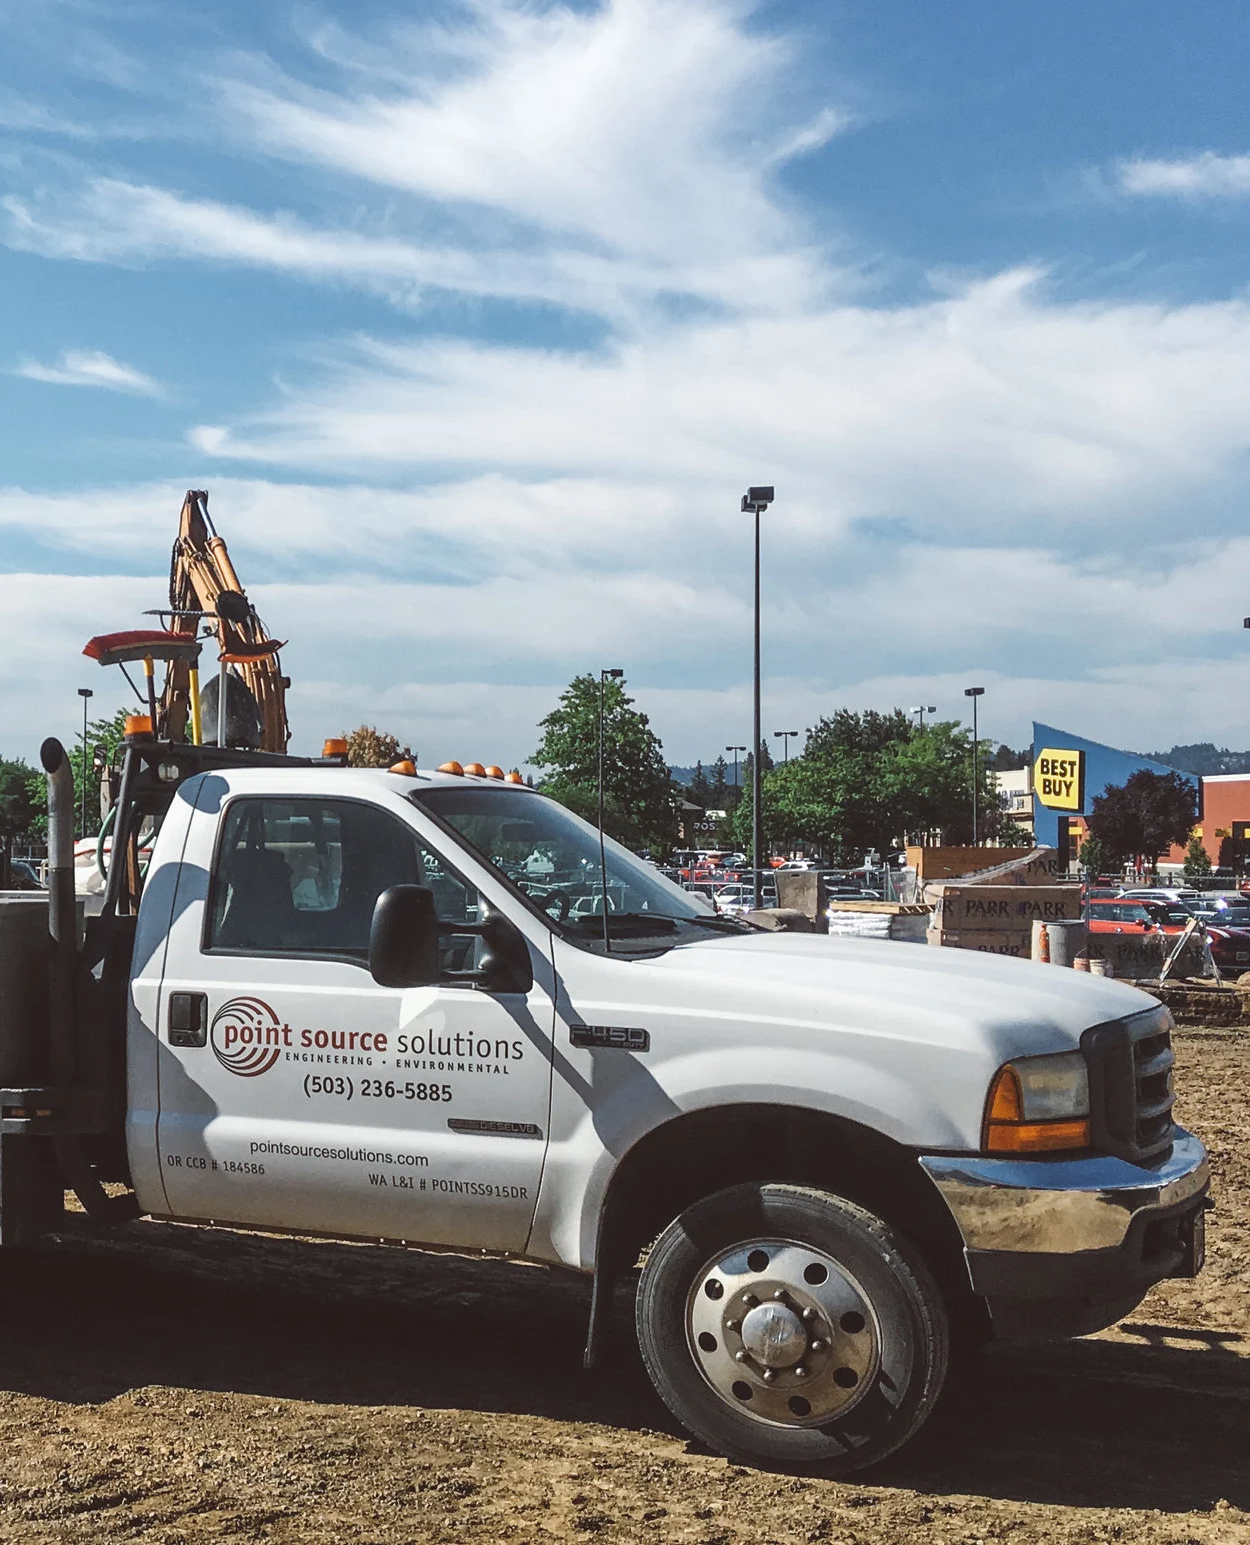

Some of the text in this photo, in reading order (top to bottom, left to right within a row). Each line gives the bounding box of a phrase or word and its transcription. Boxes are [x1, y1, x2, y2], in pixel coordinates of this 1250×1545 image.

[1040, 758, 1077, 778] BEST
[1042, 778, 1074, 797] BUY
[966, 900, 1009, 915] PARR
[1023, 901, 1065, 916] PARR
[225, 1020, 523, 1060] point source solutions
[285, 1052, 509, 1075] ENGINEERING ENVIRONMENTAL
[303, 1074, 452, 1102] (503) 236-5885
[167, 1154, 182, 1167] OR
[186, 1156, 207, 1169] CCB
[223, 1160, 265, 1175] 184586
[250, 1140, 429, 1166] pointsourcesolutions.com
[368, 1173, 388, 1186] WA
[432, 1179, 529, 1199] POINTSS915DR
